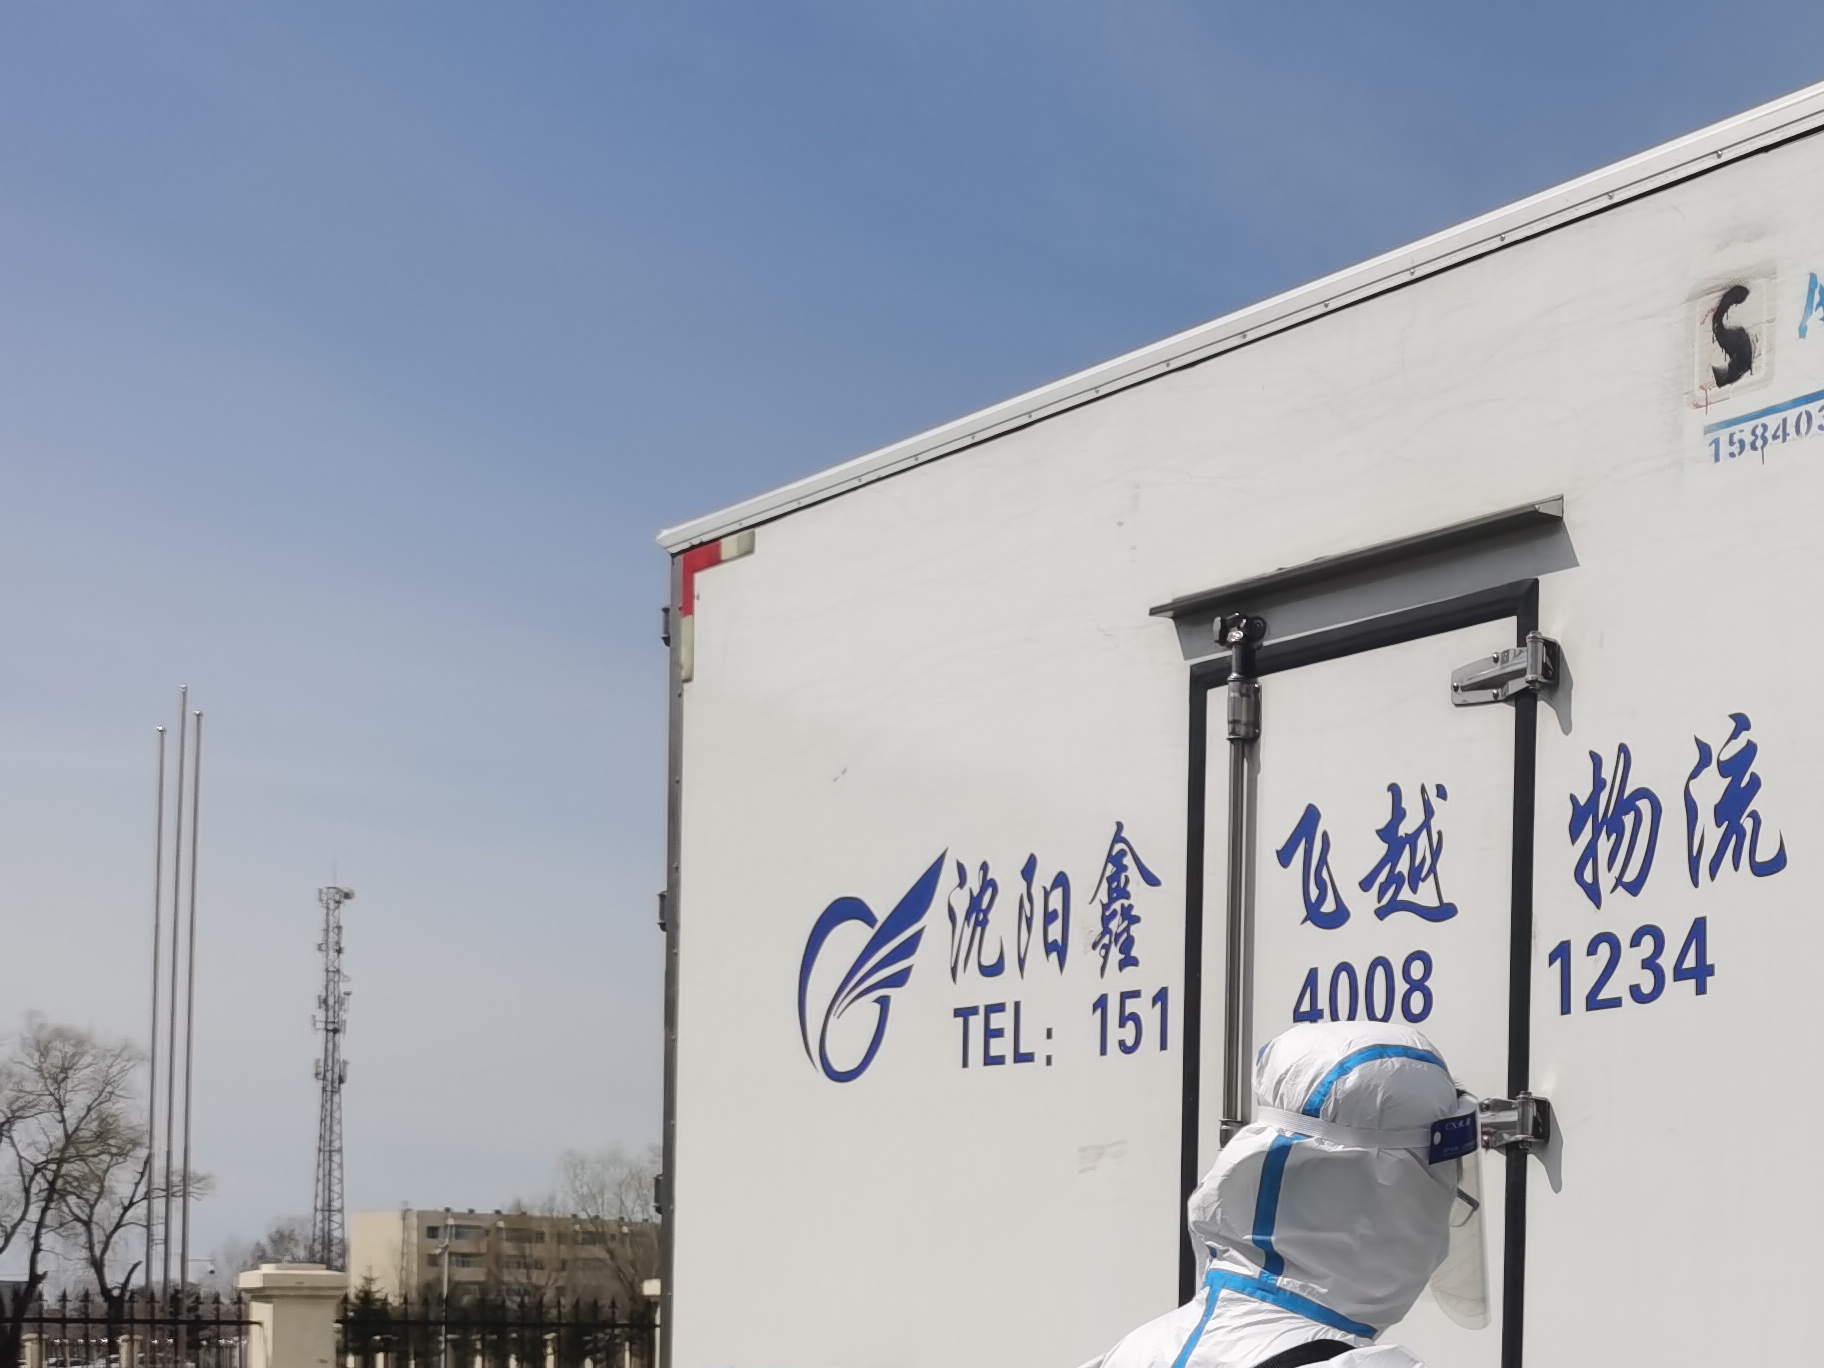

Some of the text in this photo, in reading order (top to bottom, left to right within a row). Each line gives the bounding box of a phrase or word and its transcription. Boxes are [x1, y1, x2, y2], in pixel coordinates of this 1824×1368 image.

[947, 712, 1789, 986] 沈阳鑫 飞越 物流
[1092, 986, 1170, 1057] 151
[1292, 950, 1434, 1024] 4008
[1547, 916, 1716, 1017] 1234
